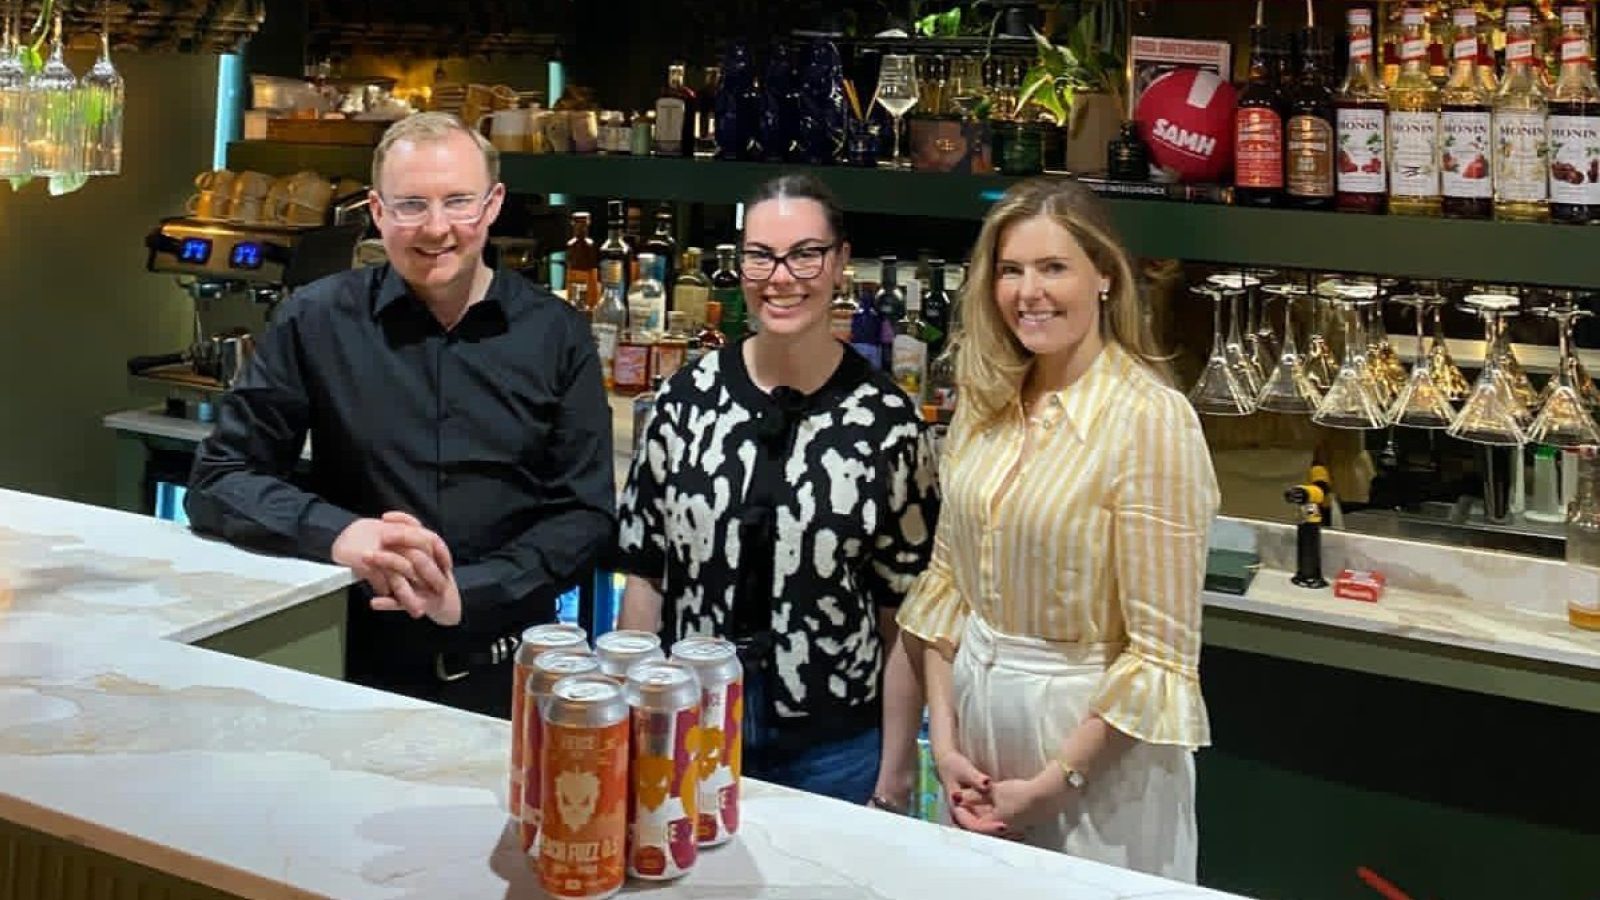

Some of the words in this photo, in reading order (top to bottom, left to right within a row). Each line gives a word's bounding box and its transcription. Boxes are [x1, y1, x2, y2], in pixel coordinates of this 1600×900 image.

[1340, 120, 1379, 131] MONIN
[1393, 122, 1434, 133] MONIN
[1444, 123, 1487, 134] MONIN
[1499, 125, 1544, 136] MONIN
[1152, 118, 1216, 156] SAMH
[1551, 127, 1597, 138] MONIN
